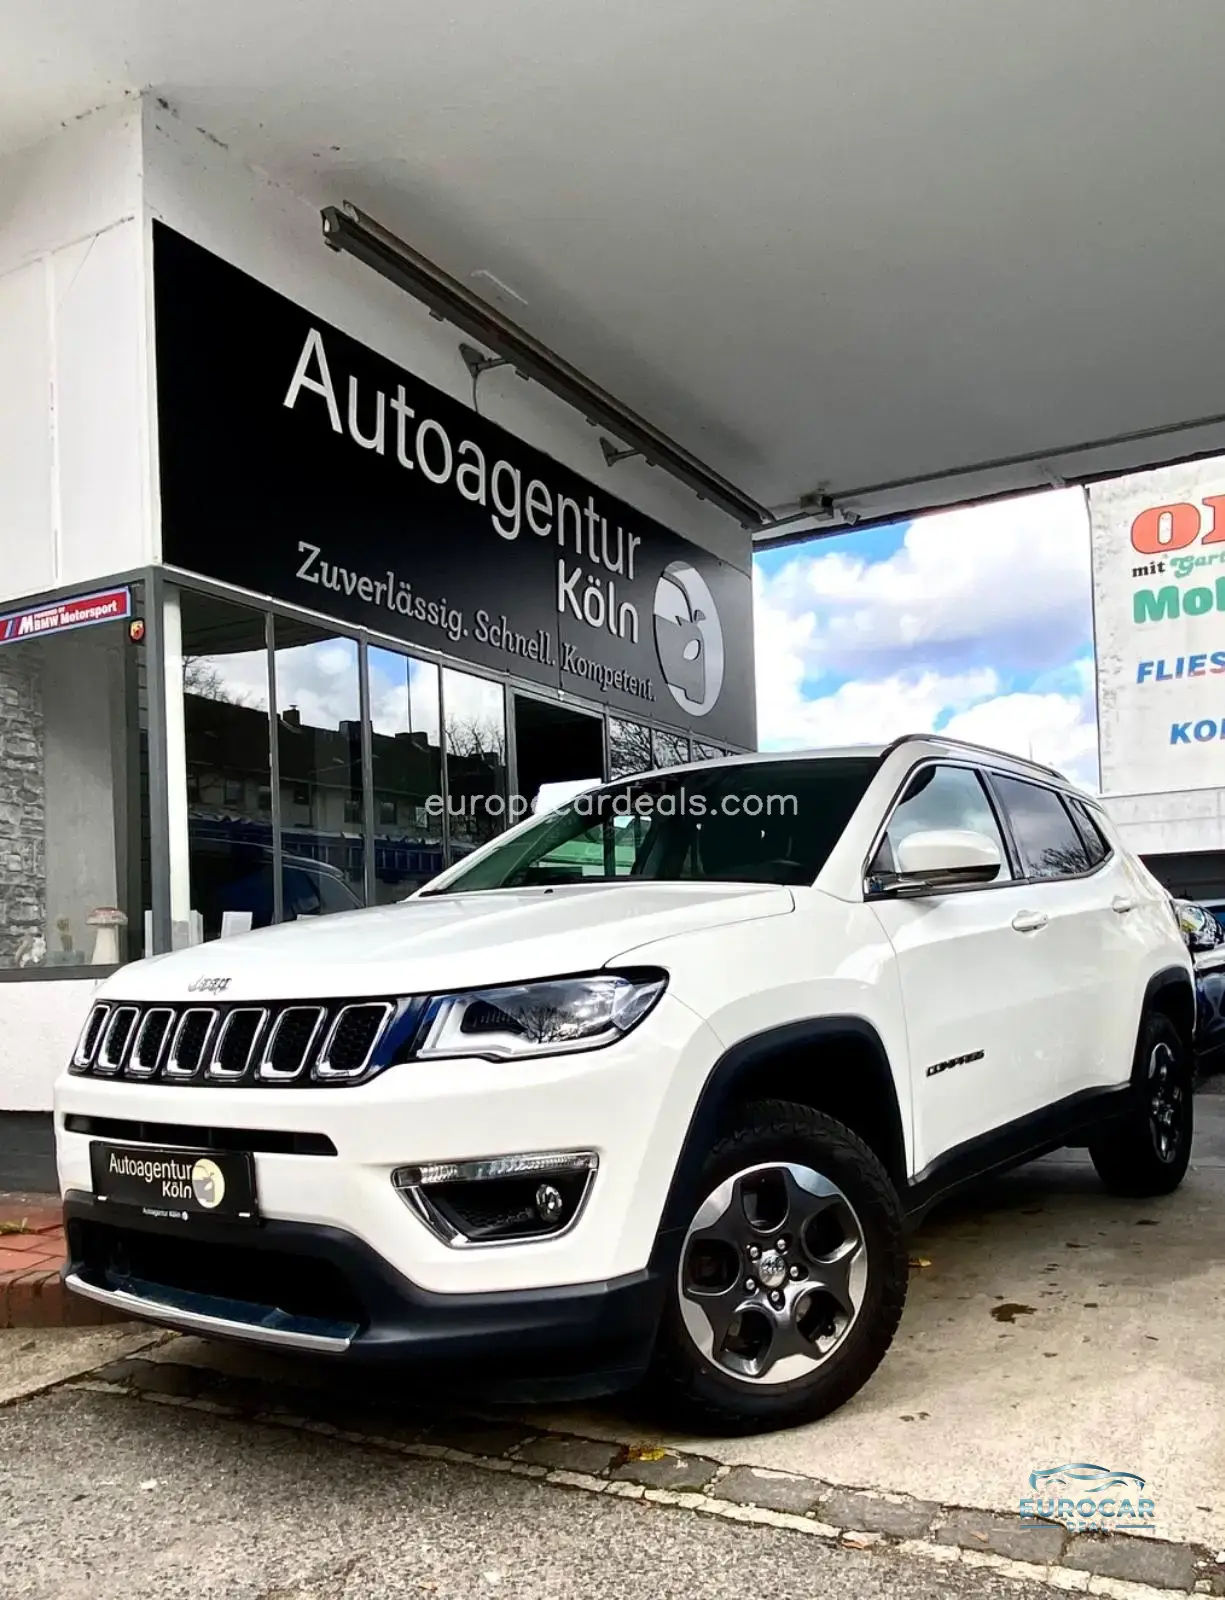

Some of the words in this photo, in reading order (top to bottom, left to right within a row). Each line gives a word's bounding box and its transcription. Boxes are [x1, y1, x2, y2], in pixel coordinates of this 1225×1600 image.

[283, 328, 641, 580] Autoagentur
[1132, 561, 1166, 578] mit
[34, 615, 59, 631] BMW
[60, 600, 117, 625] Motorsport
[558, 559, 639, 643] Köln
[296, 541, 469, 641] Zuverlässig.
[474, 610, 557, 666] Schnell.
[561, 643, 657, 702] Kompetent.
[1136, 651, 1225, 684] FLIES
[1169, 718, 1225, 745] KO
[109, 1153, 192, 1183] Autoagentur
[162, 1181, 192, 1199] Köln
